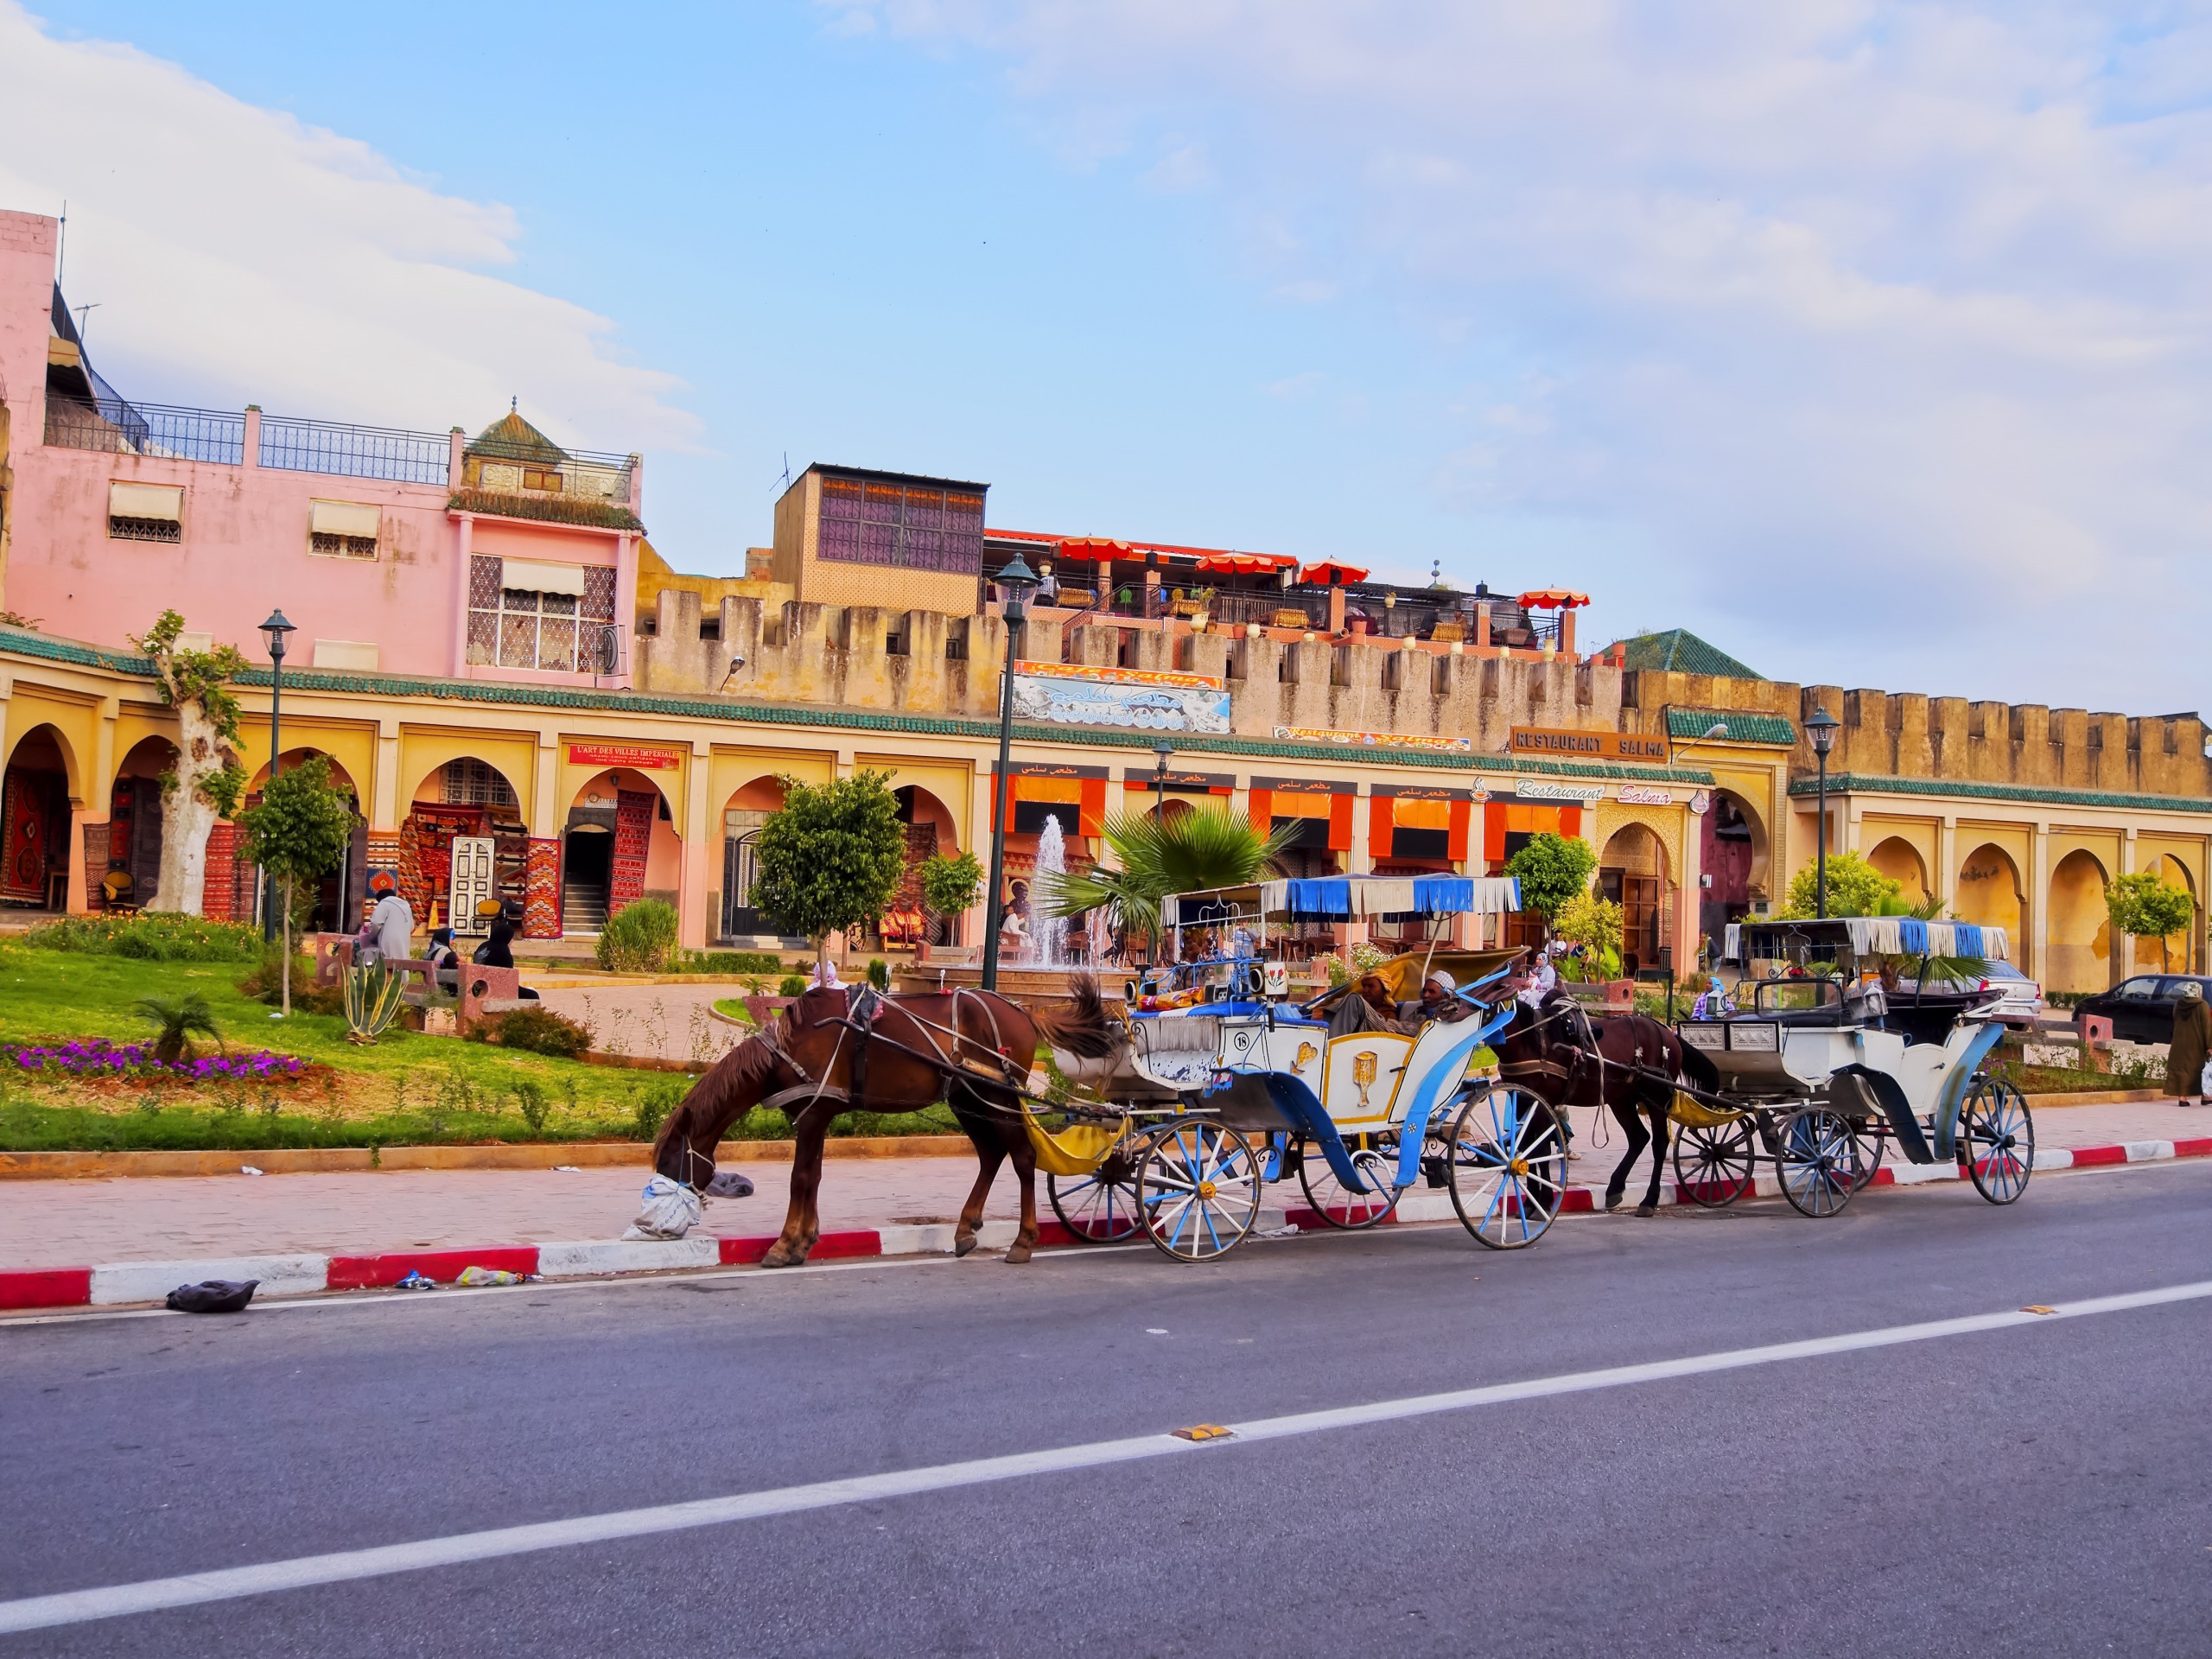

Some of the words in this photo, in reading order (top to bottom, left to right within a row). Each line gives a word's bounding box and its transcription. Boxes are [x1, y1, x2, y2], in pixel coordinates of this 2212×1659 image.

[1119, 671, 1200, 683] Salma
[1120, 690, 1183, 709] مطعم
[1050, 708, 1134, 724] Restaurant
[1137, 715, 1185, 729] Salma
[1289, 728, 1361, 738] Restaurant
[1380, 734, 1448, 744] Salma
[1516, 732, 1603, 752] RESTAURANT
[1619, 741, 1664, 757] SALMA
[1049, 766, 1078, 775] مطعم
[1179, 773, 1206, 783] مطعم
[1304, 781, 1332, 791] مطعم
[1516, 779, 1606, 800] Restaurant
[1618, 785, 1672, 804] Salma
[1422, 789, 1452, 798] مطعم
[1237, 1036, 1247, 1047] 18
